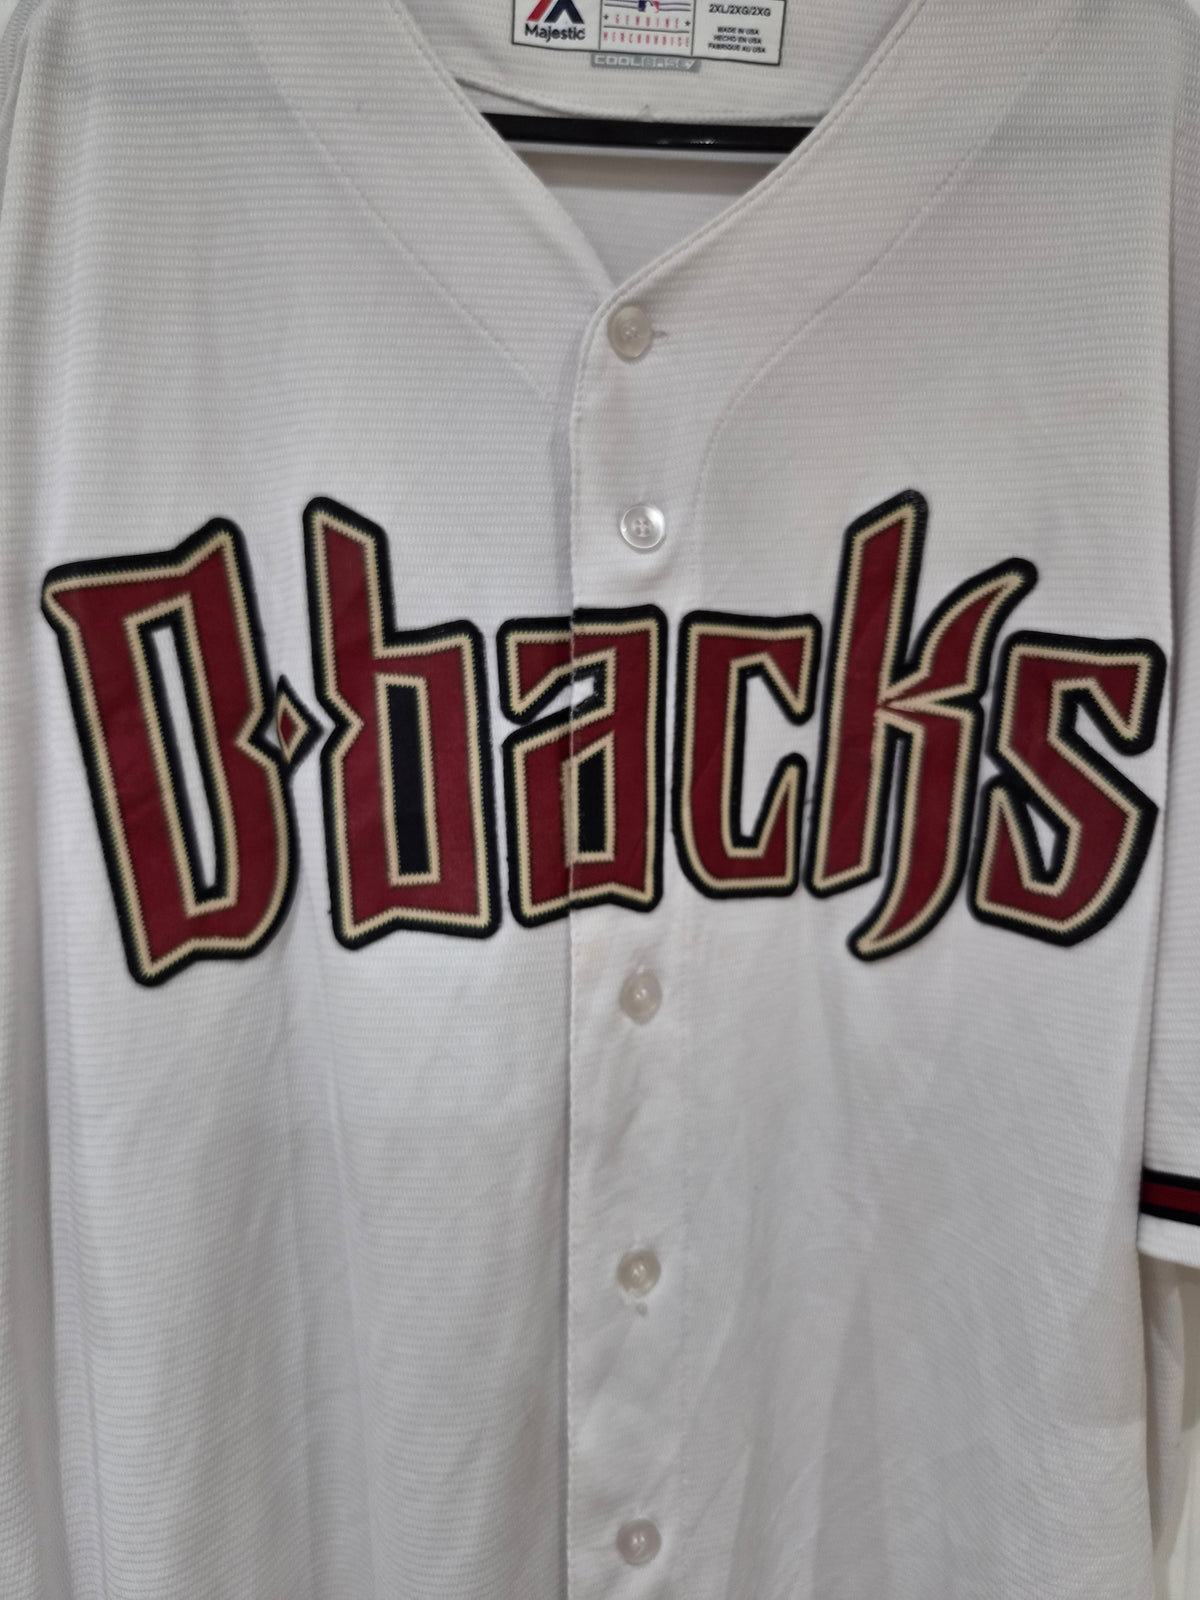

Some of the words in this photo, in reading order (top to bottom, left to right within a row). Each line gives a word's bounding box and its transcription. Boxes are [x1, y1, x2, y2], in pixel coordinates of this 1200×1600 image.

[708, 4, 771, 17] 2XL/2XG/2XG
[615, 14, 679, 29] GENUINE
[524, 23, 586, 42] Majestic
[717, 26, 737, 34] MADE
[745, 28, 759, 36] USA
[603, 31, 689, 47] MERCHANDISE
[713, 34, 737, 42] HECHO
[747, 37, 762, 45] USA
[741, 45, 751, 53] AU
[751, 46, 766, 54] USA
